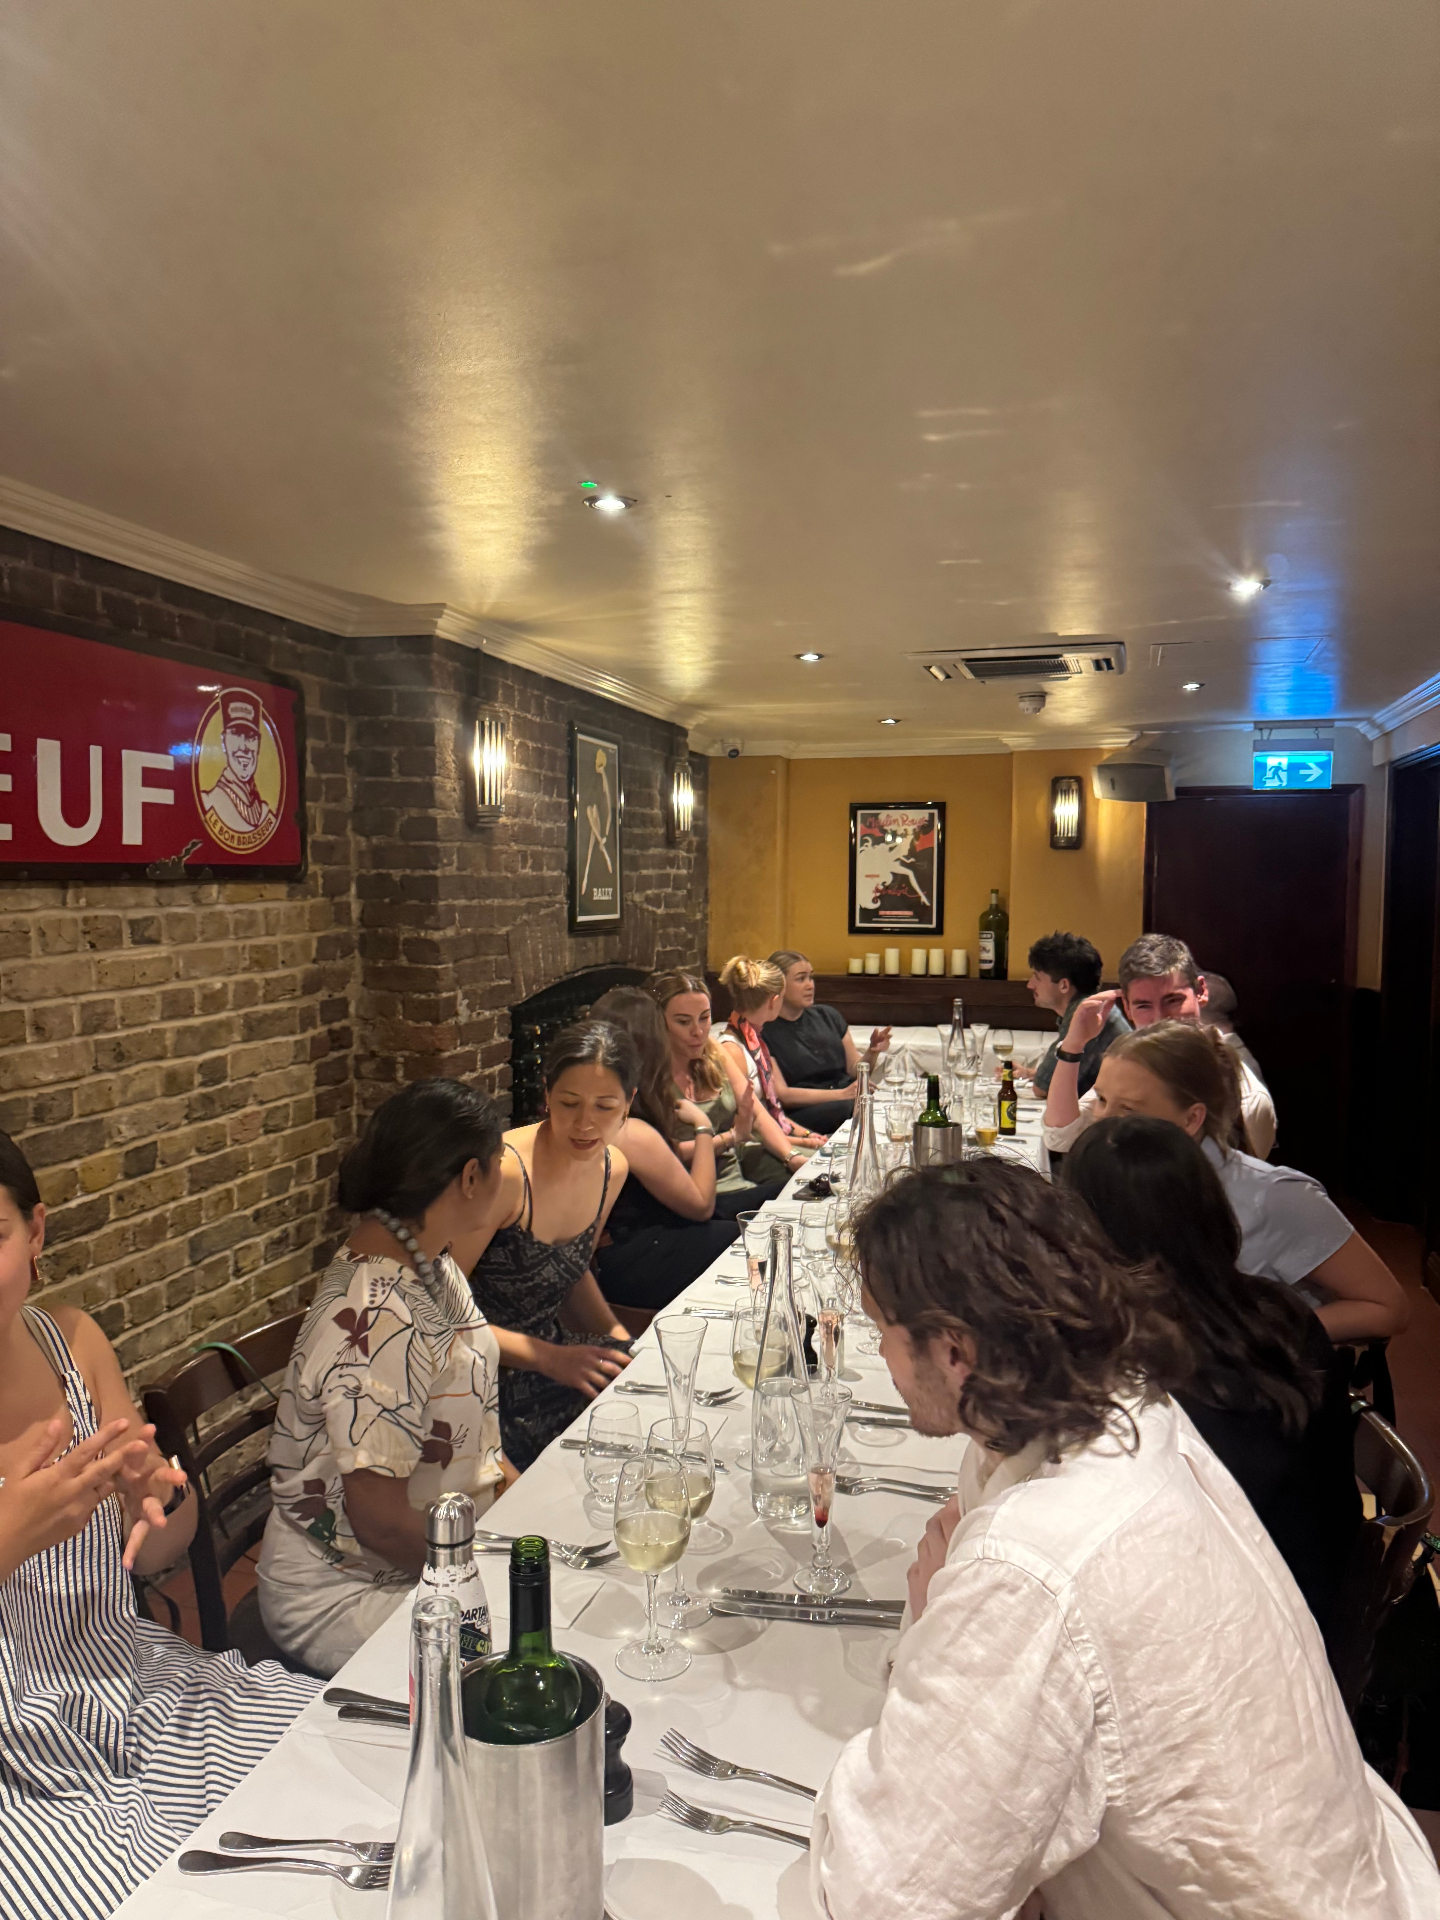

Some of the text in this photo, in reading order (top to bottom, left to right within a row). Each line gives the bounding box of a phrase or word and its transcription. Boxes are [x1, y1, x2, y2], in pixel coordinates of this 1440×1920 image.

[0, 733, 175, 847] UF
[208, 813, 219, 829] LE
[236, 817, 273, 846] BRASSEUR
[592, 887, 613, 901] BALLY
